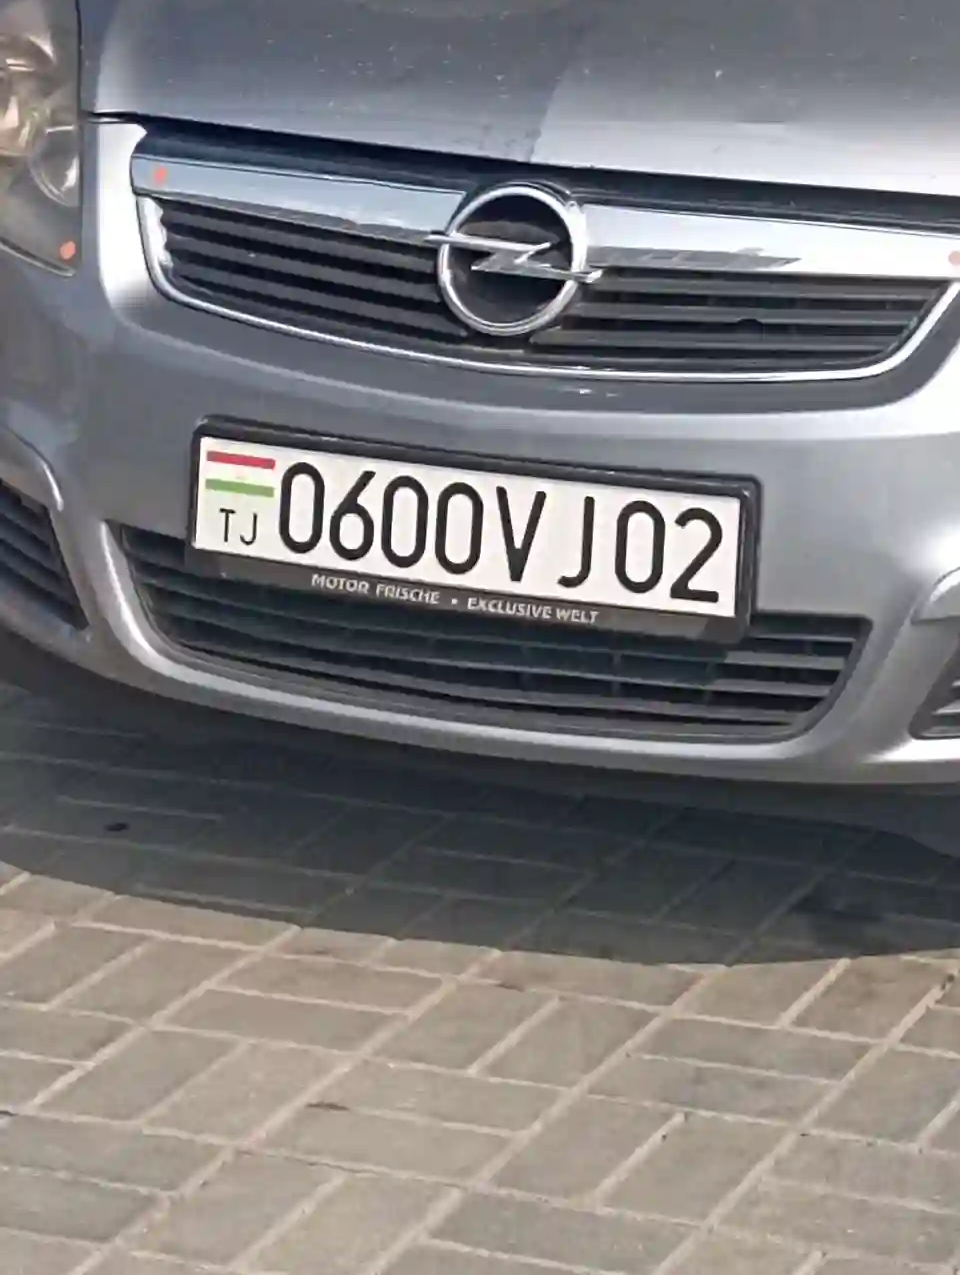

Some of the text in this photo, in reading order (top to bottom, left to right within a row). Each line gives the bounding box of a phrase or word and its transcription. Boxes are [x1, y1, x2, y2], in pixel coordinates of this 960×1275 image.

[219, 461, 723, 604] TJ 0600VJ02
[311, 573, 599, 625] MOTOR FRISCHE EXCLUSIVE WELT
